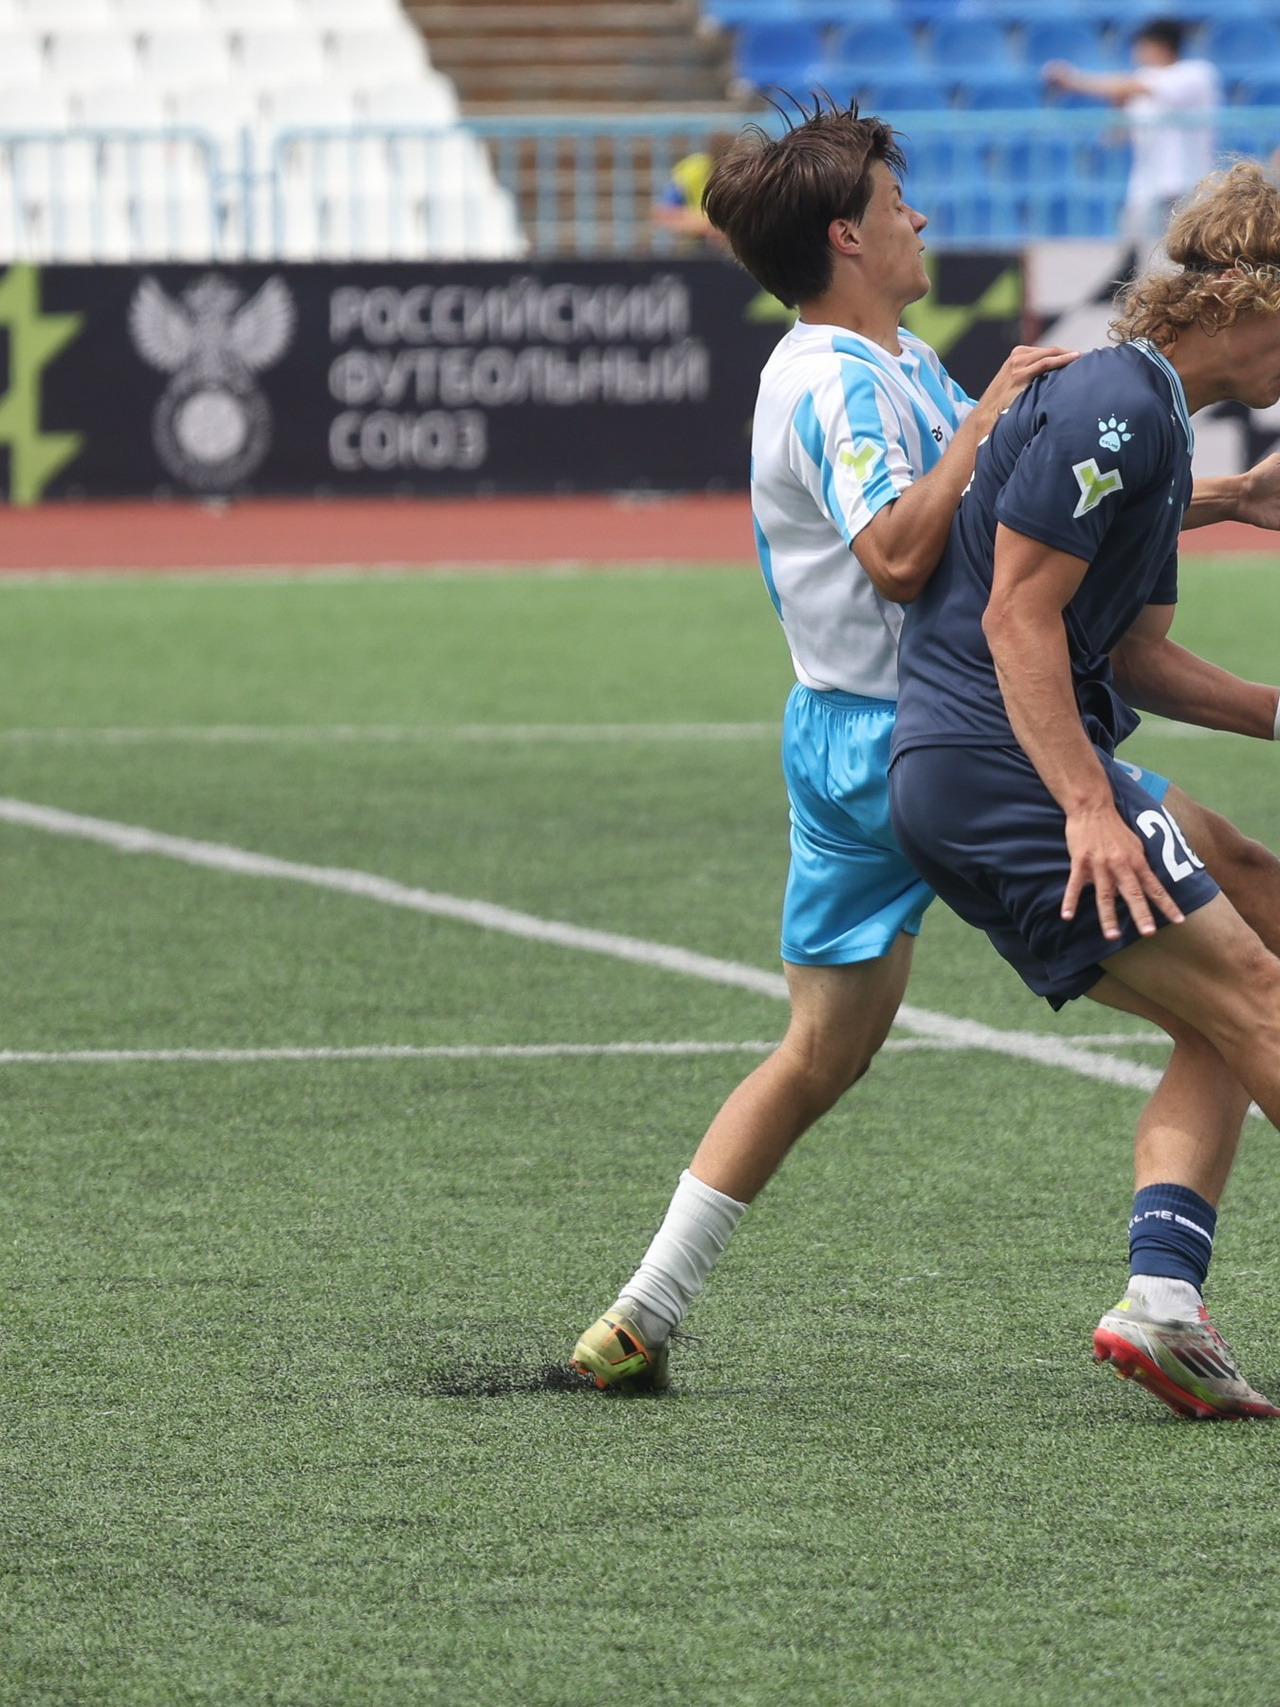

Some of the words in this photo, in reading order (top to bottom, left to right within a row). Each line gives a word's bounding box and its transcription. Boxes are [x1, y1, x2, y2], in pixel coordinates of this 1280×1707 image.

[329, 276, 689, 339] РОССИЙСКИЙ
[329, 340, 709, 405] ФУТБОЛЬНЫЙ
[328, 410, 487, 471] СОЮЗ
[1136, 804, 1205, 882] 2
